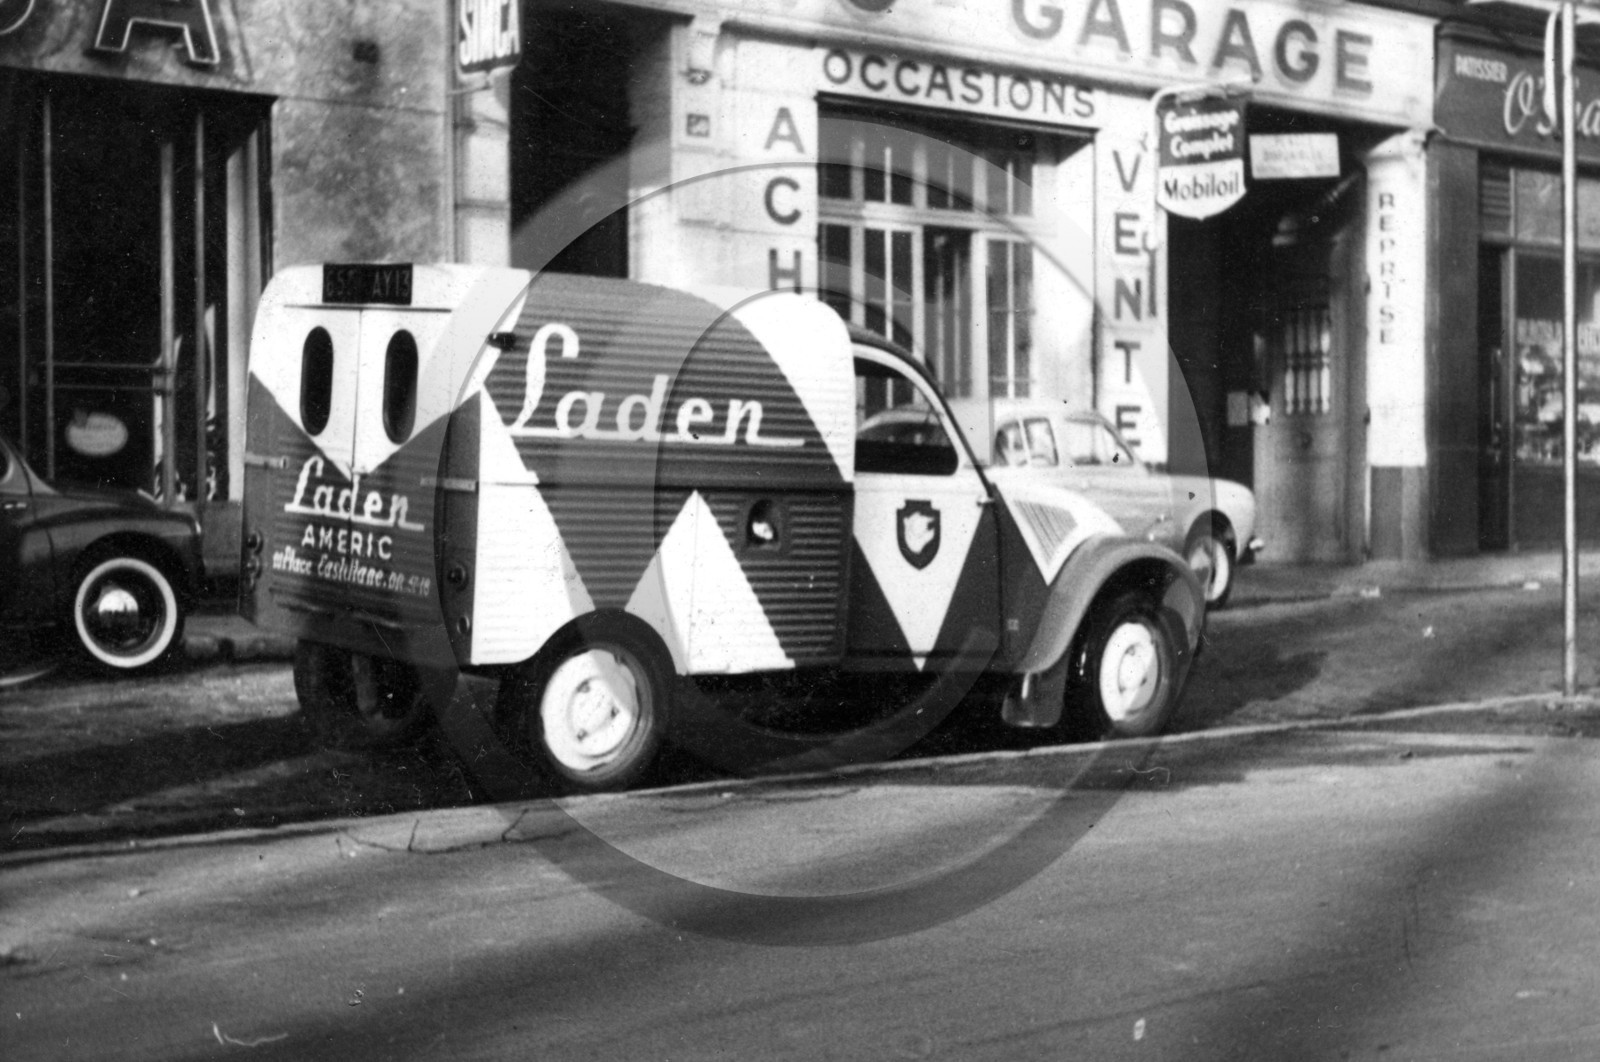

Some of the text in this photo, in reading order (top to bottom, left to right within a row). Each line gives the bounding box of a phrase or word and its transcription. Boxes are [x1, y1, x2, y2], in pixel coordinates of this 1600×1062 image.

[822, 48, 1096, 118] OCCASIONS
[1010, 0, 1375, 95] GARAGE
[1170, 131, 1234, 160] Complet
[1164, 171, 1240, 200] Mobiloil
[1113, 149, 1144, 447] VENTE
[1379, 192, 1396, 345] REPRISE
[503, 322, 805, 447] Laden
[284, 455, 425, 532] Laden
[301, 523, 393, 561] AMERIC
